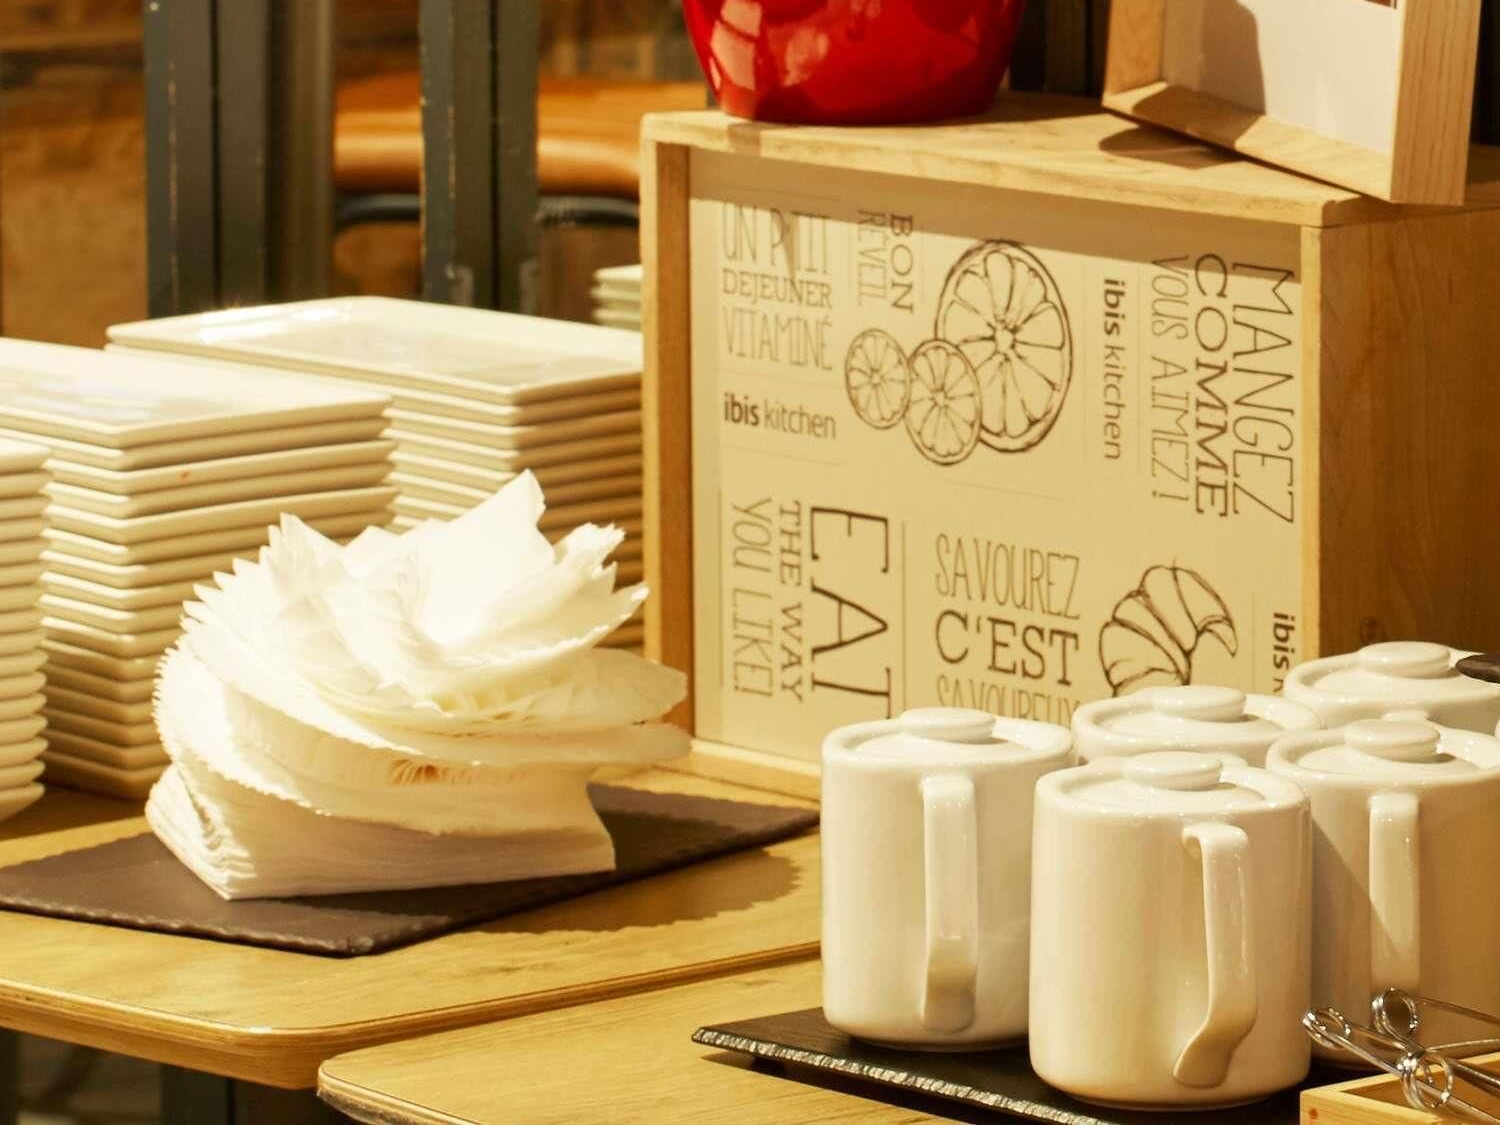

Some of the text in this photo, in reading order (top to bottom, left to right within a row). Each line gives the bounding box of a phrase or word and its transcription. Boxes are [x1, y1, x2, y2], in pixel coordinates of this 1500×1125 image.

[722, 202, 757, 263] UN
[891, 213, 914, 315] BON
[1151, 254, 1189, 340] VOUS
[1104, 278, 1126, 461] ibis kitchen
[1195, 253, 1228, 518] COMME
[1232, 262, 1295, 524] MANGEZ
[724, 391, 836, 440] ibis kitchen
[732, 497, 772, 574] YOU
[936, 533, 1080, 620] SAVOUREZ
[779, 501, 803, 703] THE WAY
[811, 506, 892, 720] EAT
[1273, 612, 1295, 670] ibis
[936, 609, 1079, 686] C'EST
